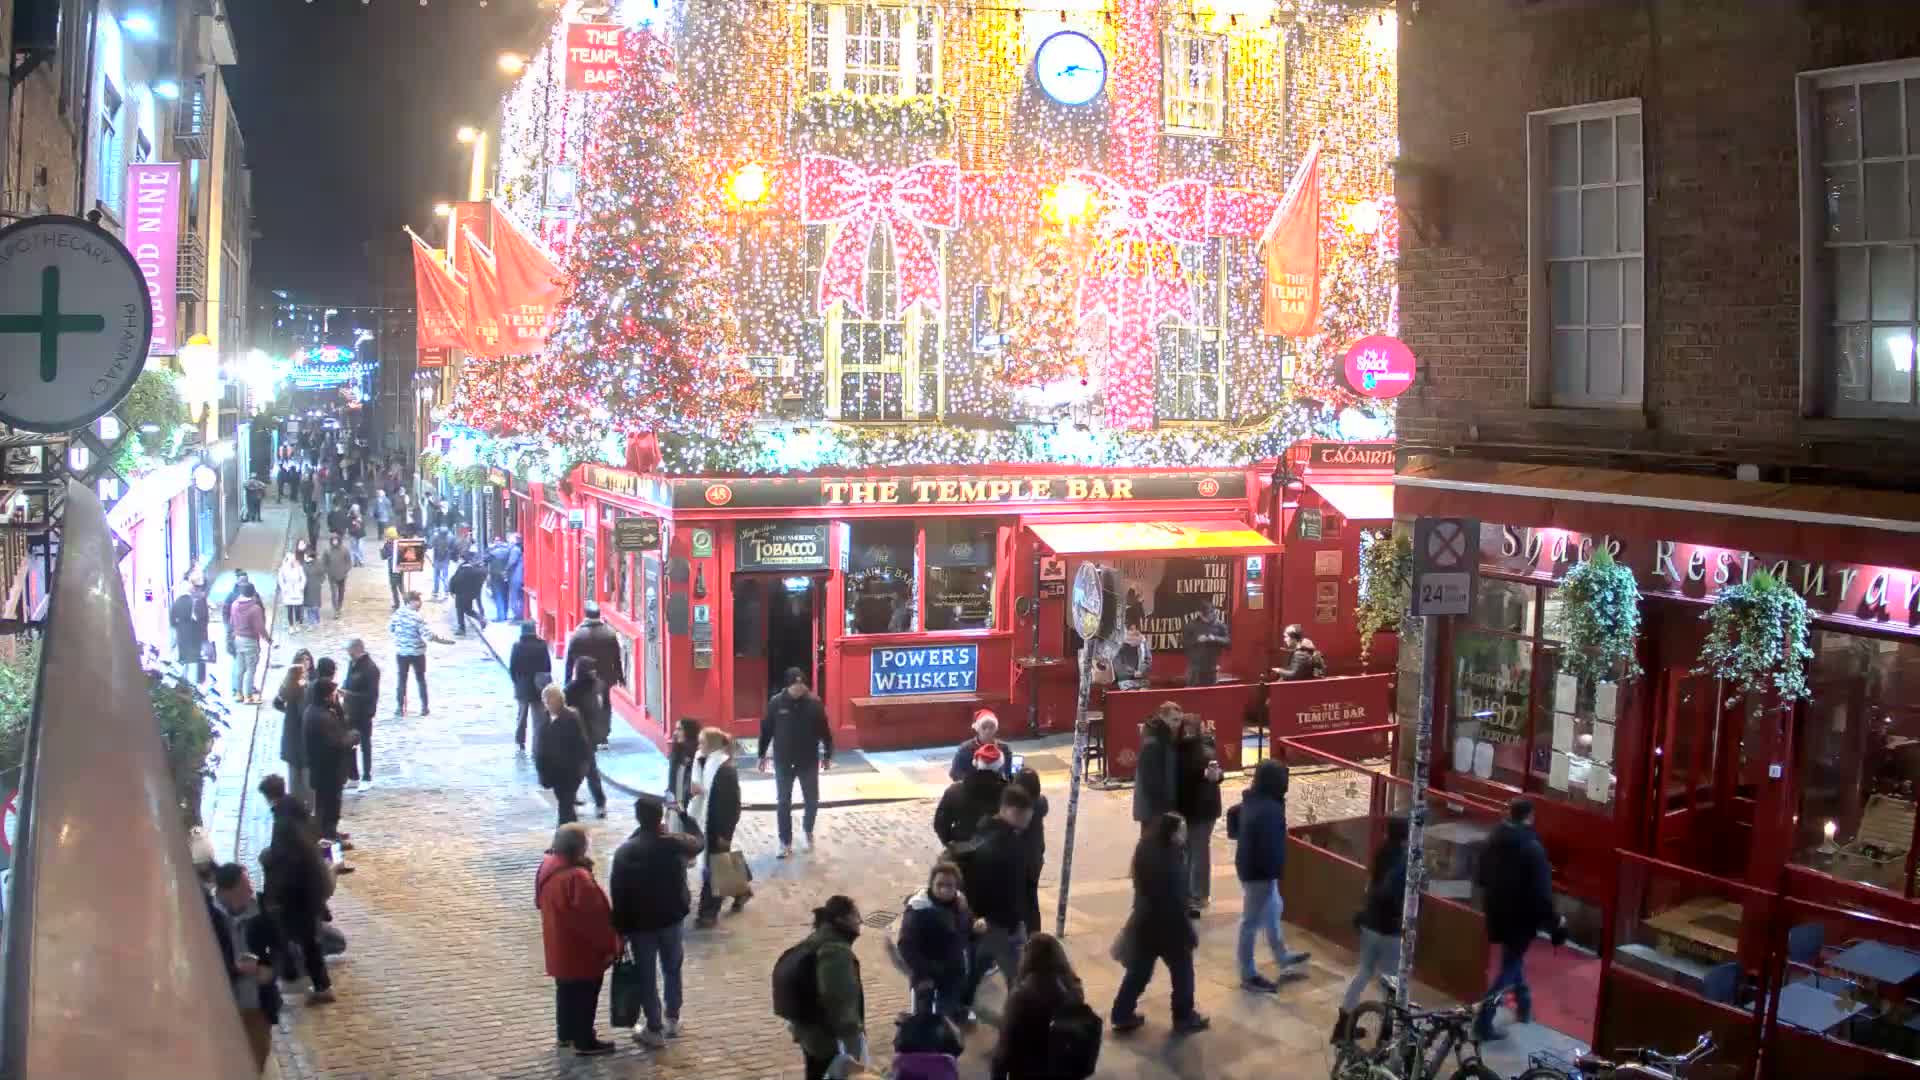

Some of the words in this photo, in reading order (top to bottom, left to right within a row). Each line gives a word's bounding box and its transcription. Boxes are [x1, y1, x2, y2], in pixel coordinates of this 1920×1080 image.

[586, 29, 619, 46] THE
[137, 171, 170, 233] NINE
[502, 313, 553, 327] TEMP
[824, 481, 899, 505] THE
[912, 479, 1051, 504] TEMPLE
[1065, 478, 1134, 499] BAR
[752, 540, 817, 562] TOBACCO
[1501, 523, 1622, 567] Shack
[1204, 563, 1228, 578] THE
[1176, 578, 1227, 594] EMPEROR
[1423, 583, 1443, 604] 24
[1212, 593, 1226, 608] OF
[880, 647, 970, 668] POWER'S
[874, 670, 975, 691] WHISKEY
[1296, 711, 1341, 725] TEMPLE
[1342, 706, 1366, 721] BAR
[1321, 703, 1341, 712] THE
